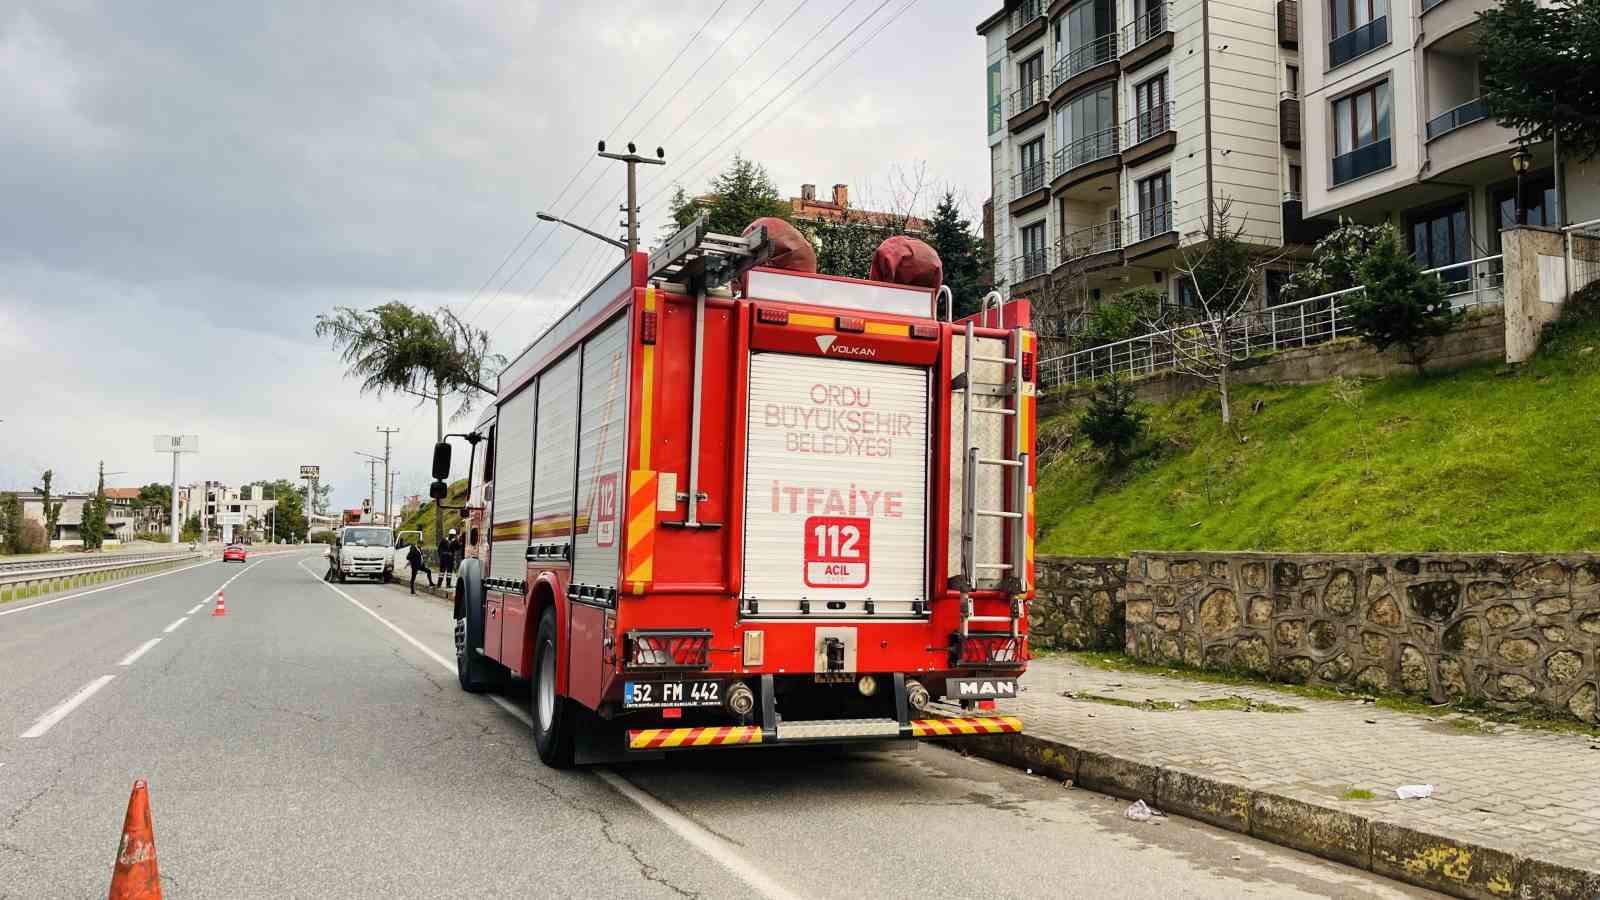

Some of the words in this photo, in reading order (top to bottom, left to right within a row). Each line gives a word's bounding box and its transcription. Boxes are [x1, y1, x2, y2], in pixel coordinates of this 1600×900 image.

[831, 344, 876, 357] VOLKAN
[809, 383, 871, 408] ORDU
[600, 481, 614, 516] 112
[771, 480, 903, 518] İTFAİYE
[814, 524, 860, 558] 112
[633, 684, 652, 702] 52
[663, 683, 683, 701] FM
[691, 682, 719, 701] 442
[959, 681, 1014, 695] MAN
